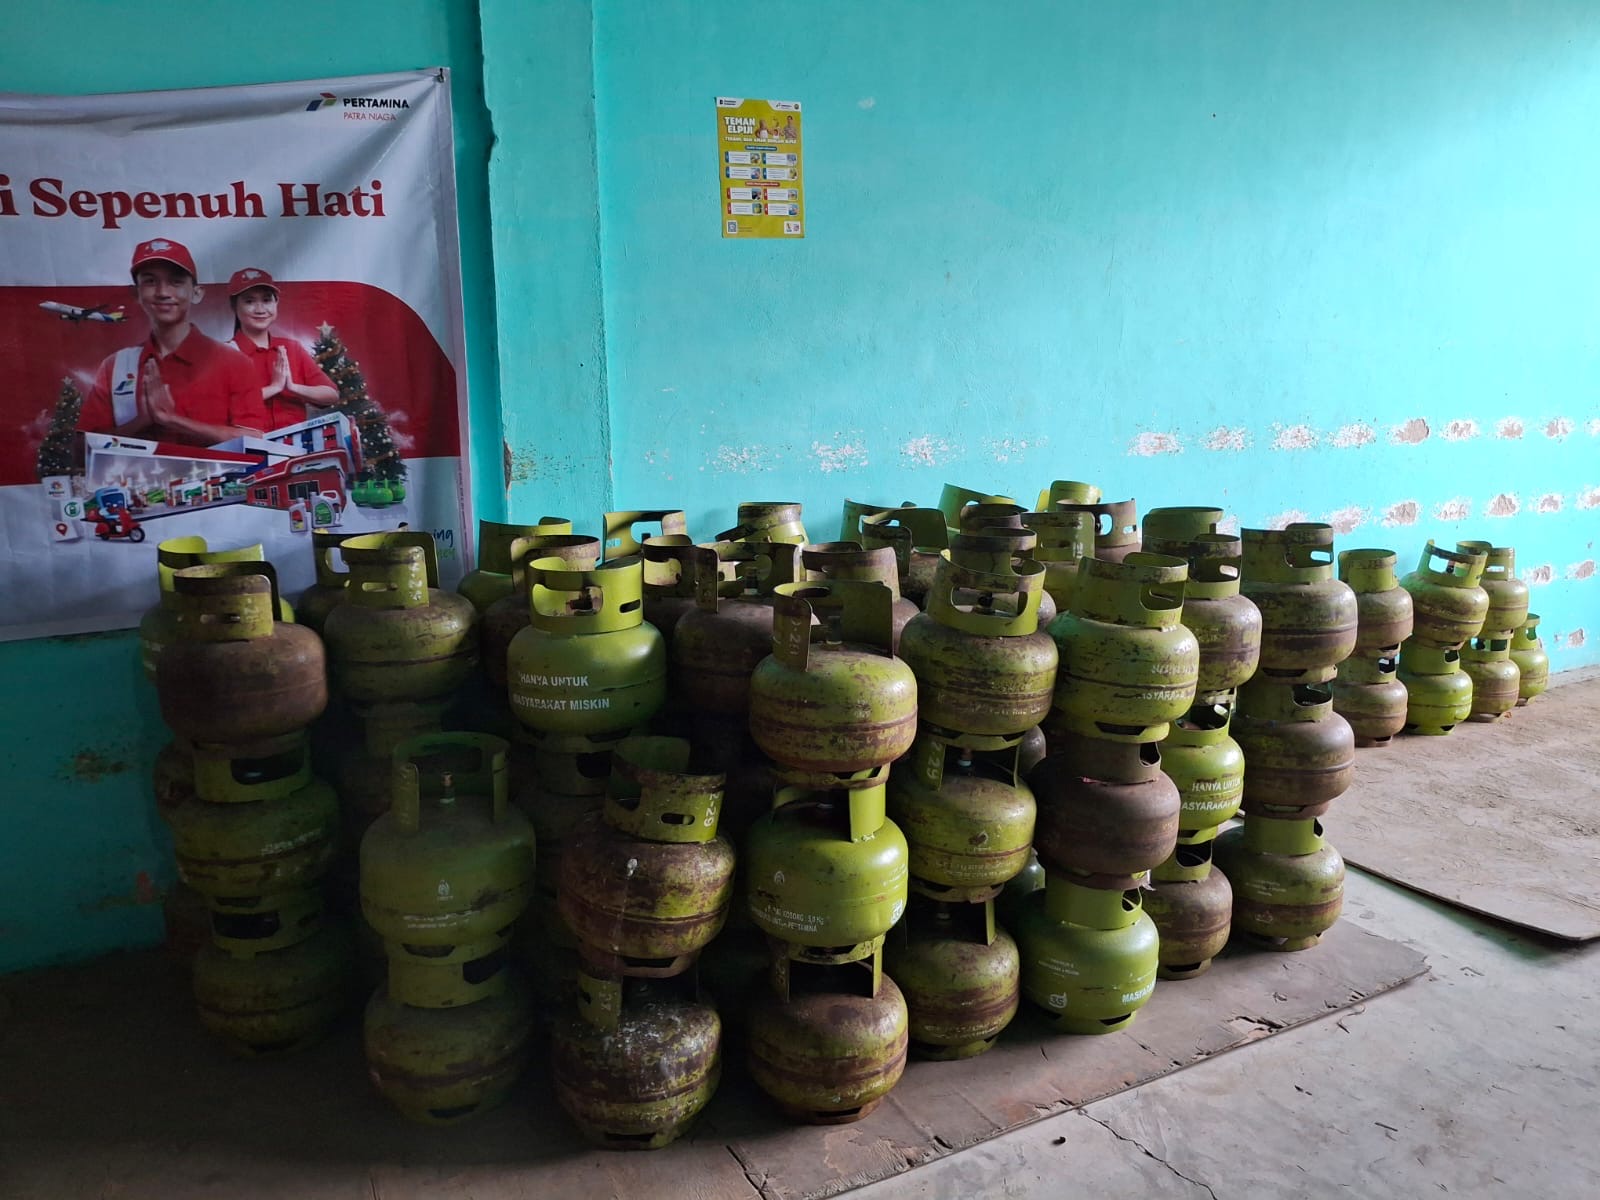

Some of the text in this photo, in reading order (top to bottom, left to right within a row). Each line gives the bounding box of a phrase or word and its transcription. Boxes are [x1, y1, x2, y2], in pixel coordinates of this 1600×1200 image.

[343, 98, 410, 109] PERTAMINA
[343, 112, 397, 121] PATRA NIAGA
[724, 116, 756, 126] TEMAN
[29, 178, 267, 229] Sepenuh
[277, 180, 386, 217] Hati
[550, 675, 589, 687] UNTUK
[570, 698, 610, 711] MISKIN
